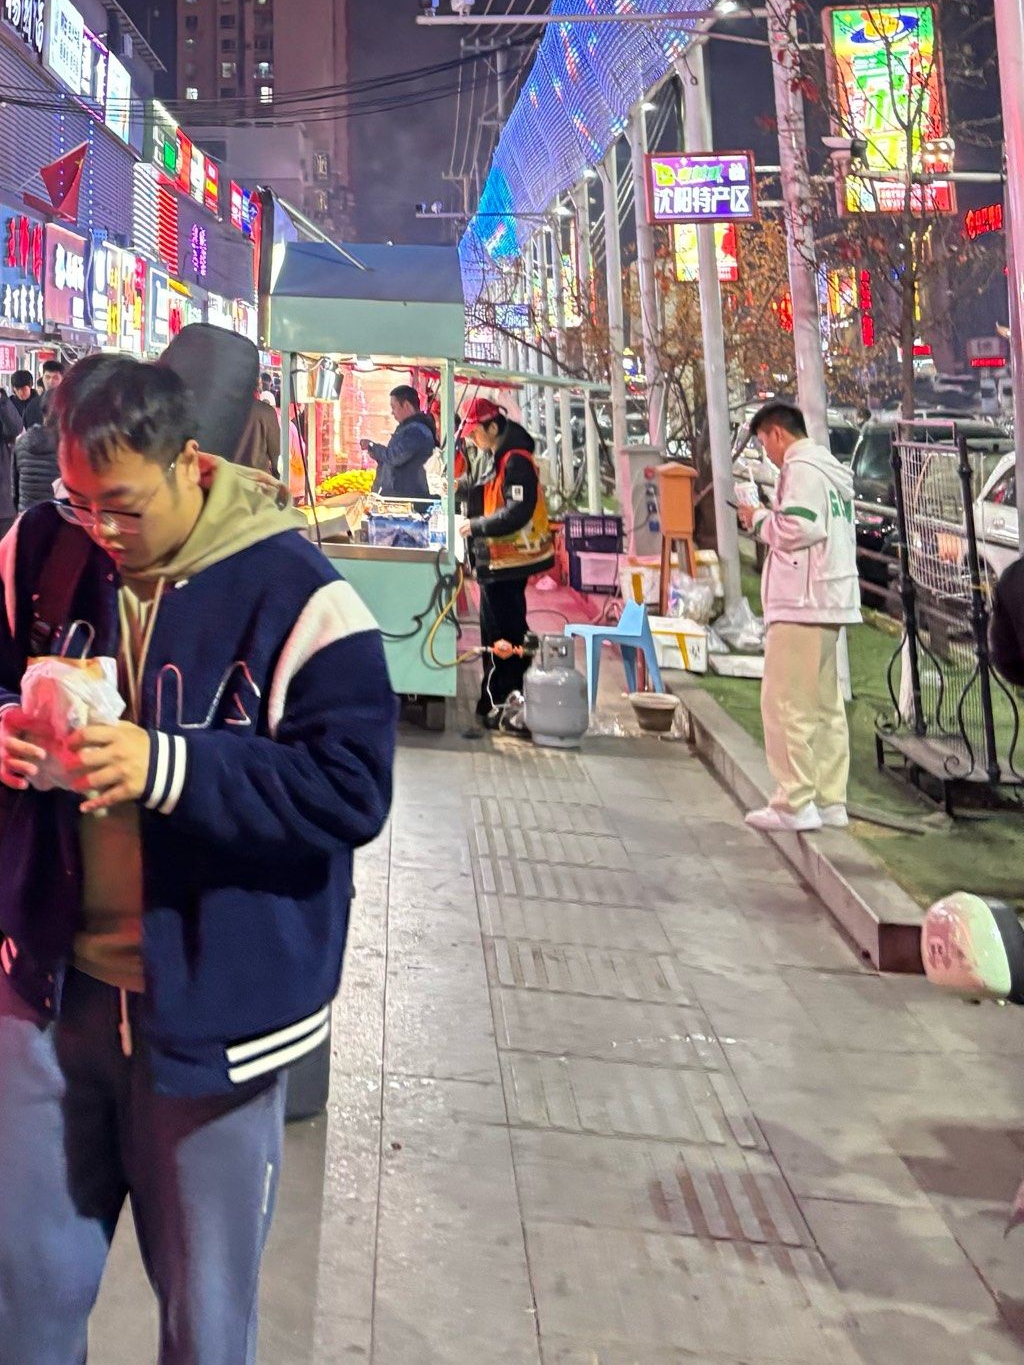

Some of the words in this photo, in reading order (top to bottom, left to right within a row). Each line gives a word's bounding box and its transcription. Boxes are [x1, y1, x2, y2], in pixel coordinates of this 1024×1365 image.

[654, 185, 751, 214] 沈阳特产区
